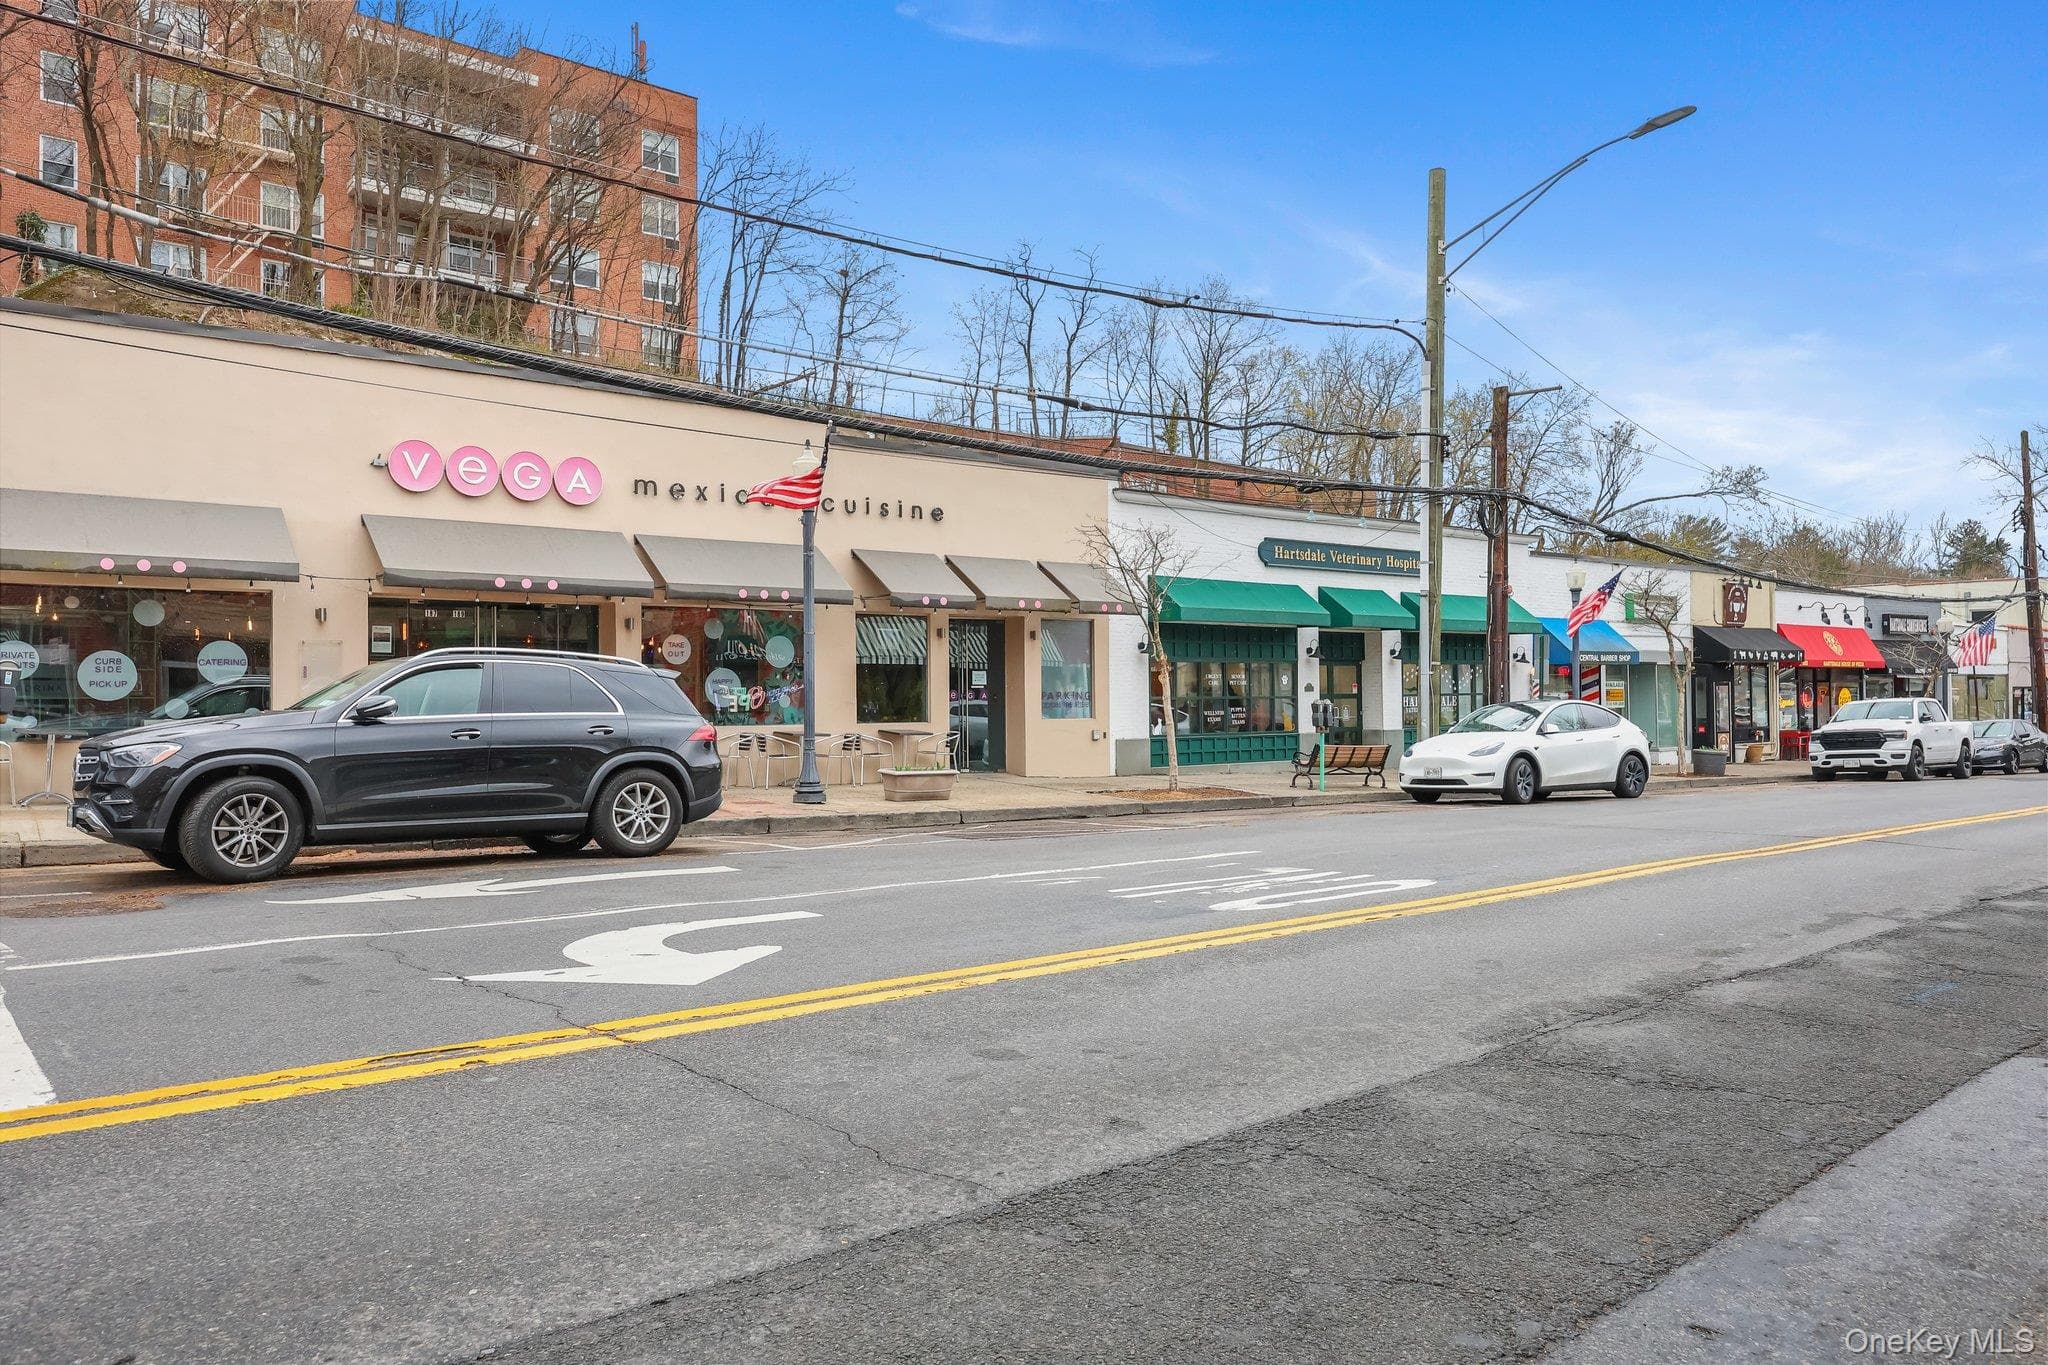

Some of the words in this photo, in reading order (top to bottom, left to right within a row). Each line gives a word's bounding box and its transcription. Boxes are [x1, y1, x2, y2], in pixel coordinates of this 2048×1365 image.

[633, 477, 776, 508] mexic
[821, 497, 945, 522] cuisine
[1274, 545, 1326, 562] Hartsdale
[1330, 550, 1382, 570] Veterinary
[1386, 555, 1421, 571] Hospita
[0, 651, 35, 659] RIVATE
[1601, 654, 1617, 662] BARBER
[1619, 654, 1631, 662] SHOP
[94, 657, 122, 665] CURB
[198, 658, 247, 667] CATERING
[94, 665, 122, 673] SIDE
[89, 680, 111, 688] PICK
[114, 680, 128, 688] UP
[1041, 690, 1091, 701] PARKING
